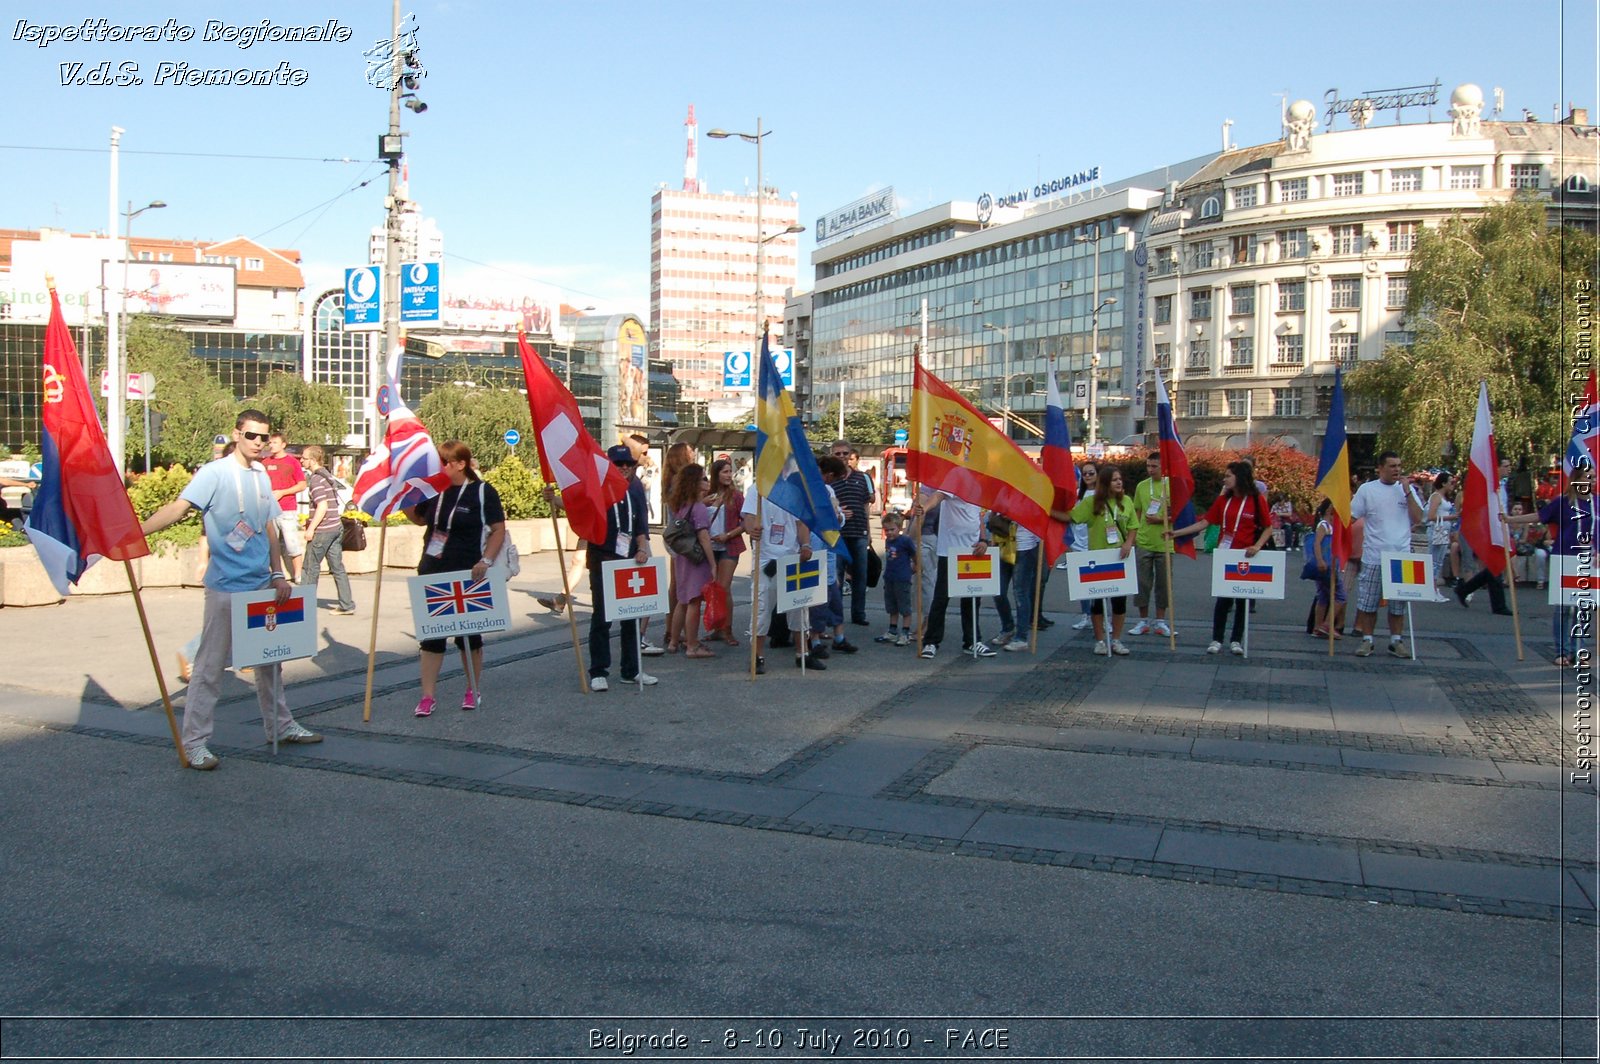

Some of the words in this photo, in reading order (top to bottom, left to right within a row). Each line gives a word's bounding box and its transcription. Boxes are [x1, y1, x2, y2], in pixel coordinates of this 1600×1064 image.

[997, 188, 1029, 209] DUNAV
[1033, 166, 1100, 198] OSIGURANJE
[829, 208, 858, 233] ALPHA
[858, 195, 888, 221] BANK
[1088, 585, 1120, 595] Slovenia
[1231, 585, 1264, 595] Slovakia
[617, 600, 658, 616] Switzerland
[421, 621, 457, 635] United
[459, 617, 506, 631] Kingdom
[262, 644, 292, 659] Serbia
